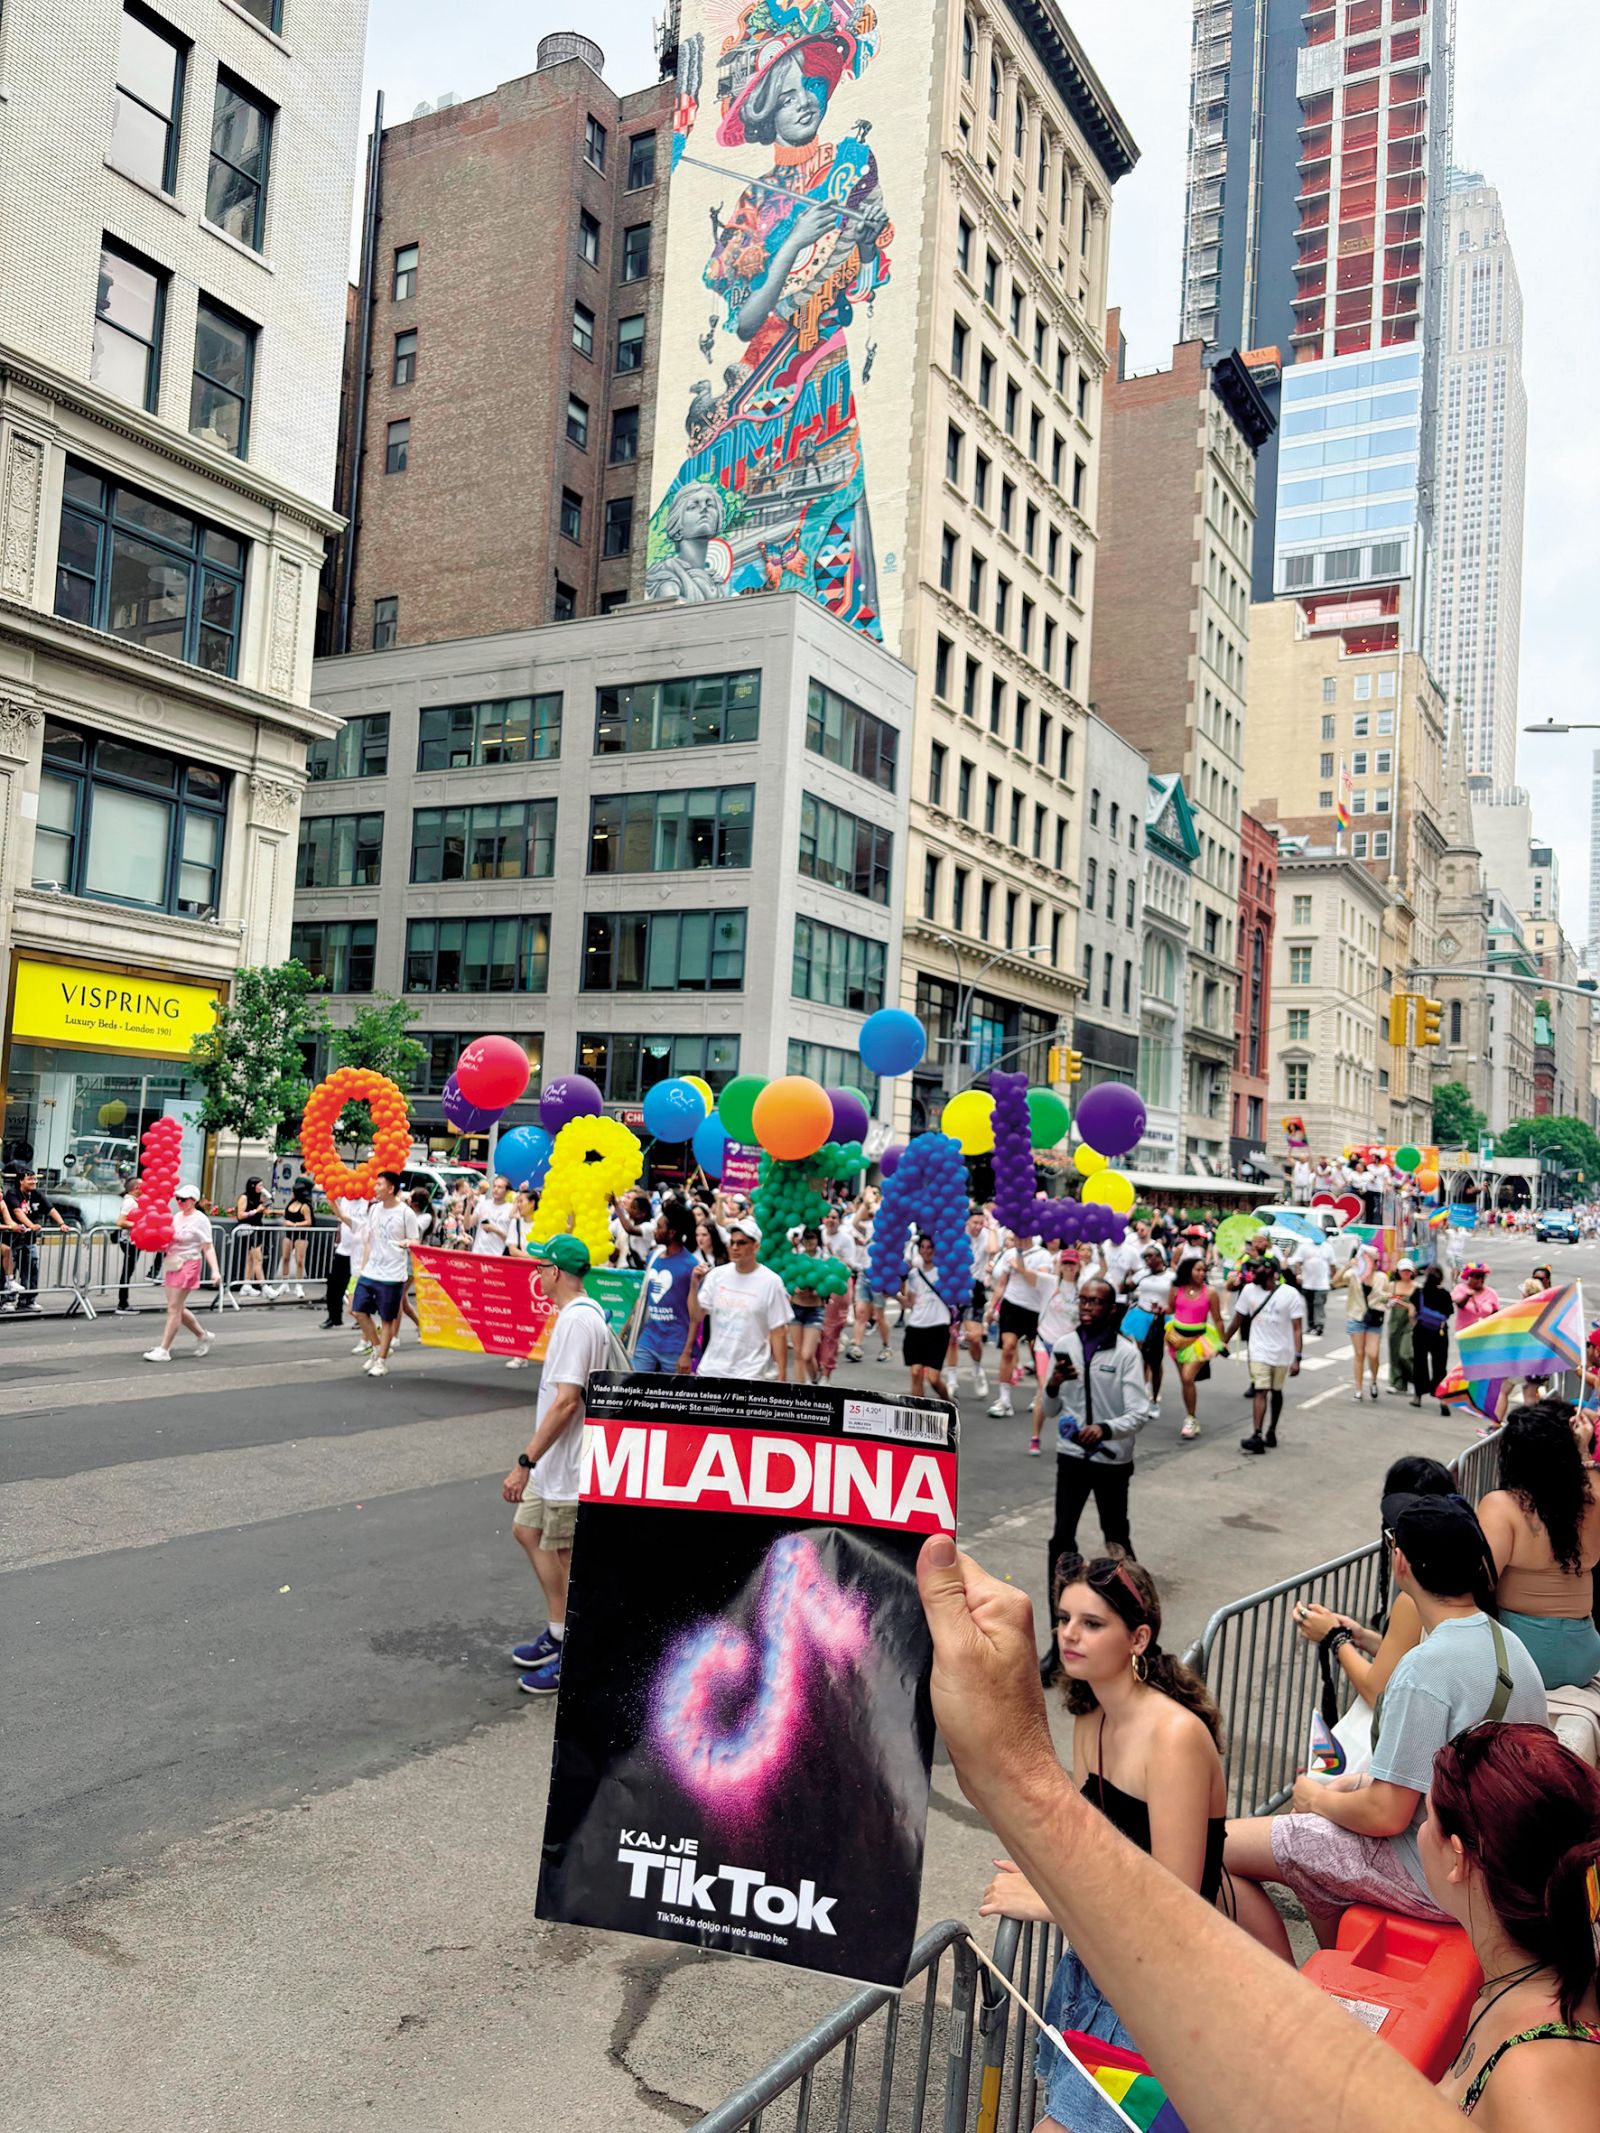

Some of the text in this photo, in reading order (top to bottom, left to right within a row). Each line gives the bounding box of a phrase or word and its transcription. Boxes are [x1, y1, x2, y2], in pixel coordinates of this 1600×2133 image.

[61, 983, 180, 1019] VISPRING
[65, 1014, 96, 1029] Luxury
[98, 1019, 117, 1030] Beds
[125, 1022, 155, 1034] London
[157, 1027, 172, 1036] 1901
[8, 1115, 46, 1126] VISPING
[592, 1384, 611, 1392] Vlado
[611, 1385, 644, 1395] Miheljak:
[644, 1387, 674, 1397] Janševa
[674, 1389, 698, 1398] zdrava
[699, 1391, 722, 1400] telesa
[722, 1392, 731, 1401] //
[748, 1394, 768, 1404] Kevin
[769, 1396, 794, 1407] Spacey
[794, 1399, 812, 1408] hoče
[633, 1400, 658, 1410] Priloga
[660, 1402, 688, 1411] Bivanje:
[689, 1403, 702, 1412] Sto
[703, 1405, 735, 1414] milijonov
[746, 1408, 773, 1418] gradnjo
[774, 1410, 795, 1419] javnih
[796, 1413, 831, 1424] stanovanj
[849, 1404, 861, 1414] 25
[579, 1424, 956, 1531] MLADINA
[620, 1829, 699, 1856] KAJ JE
[617, 1848, 838, 1936] TikTok
[657, 1911, 788, 1945] TikTok že dolgo ni več samo hec
